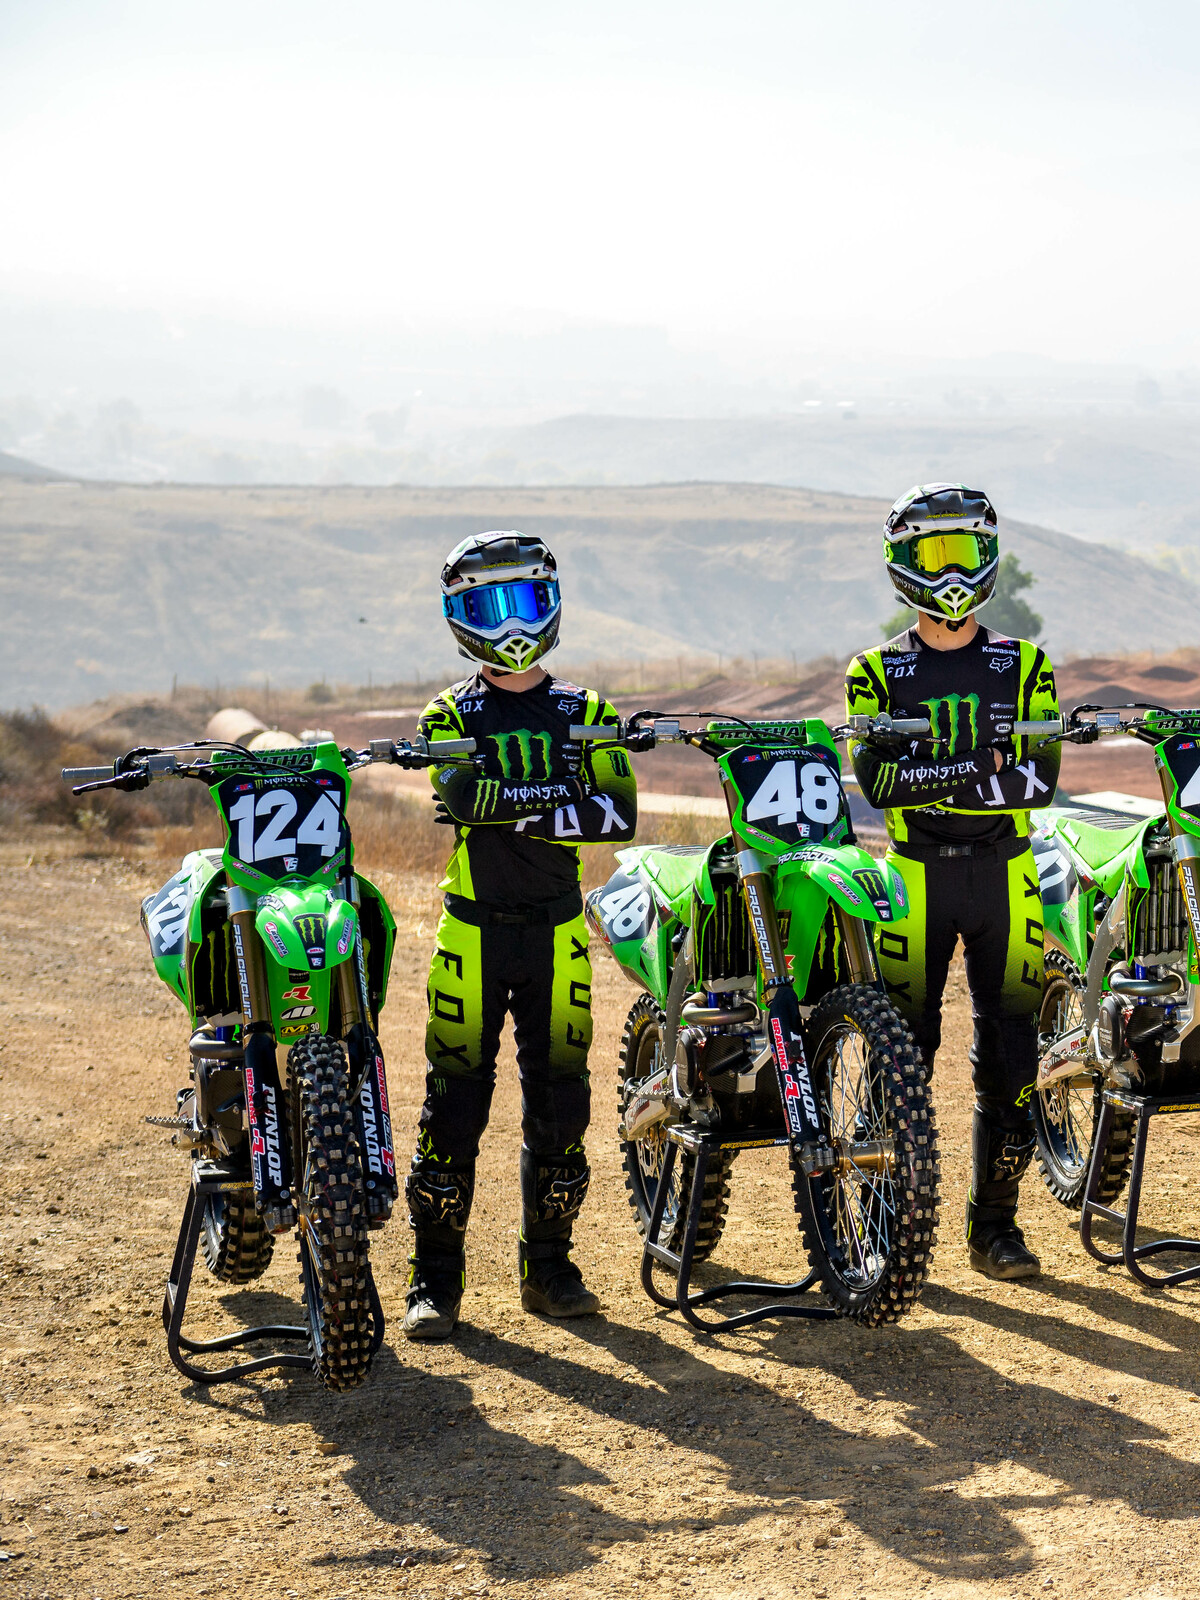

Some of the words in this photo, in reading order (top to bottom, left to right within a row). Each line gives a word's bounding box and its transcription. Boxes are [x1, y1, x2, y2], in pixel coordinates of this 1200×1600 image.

[886, 664, 917, 678] FOX
[982, 646, 1020, 657] Kawasaki
[770, 749, 812, 758] MONSTER
[900, 761, 978, 783] MONSTER
[746, 760, 840, 826] 48
[911, 777, 967, 792] ENERGY
[229, 788, 341, 864] 124
[791, 850, 836, 864] CIRCUIT
[1182, 866, 1195, 898] PRO
[149, 886, 189, 953] 124
[599, 882, 650, 938] 48
[747, 884, 762, 916] PRO
[754, 916, 776, 973] CIRCUIT
[1020, 872, 1044, 990] FOX
[232, 924, 244, 957] PRO
[238, 958, 253, 1019] CIRCUIT
[566, 935, 590, 1050] FOX
[434, 949, 471, 1069] FOX
[771, 1018, 788, 1071] BRAKING
[1070, 1039, 1081, 1050] RK
[245, 1068, 258, 1125] BRAKING
[376, 1055, 389, 1114] BRAKING
[262, 1083, 282, 1187] DUNLOP
[358, 1073, 382, 1175] DUNLOP
